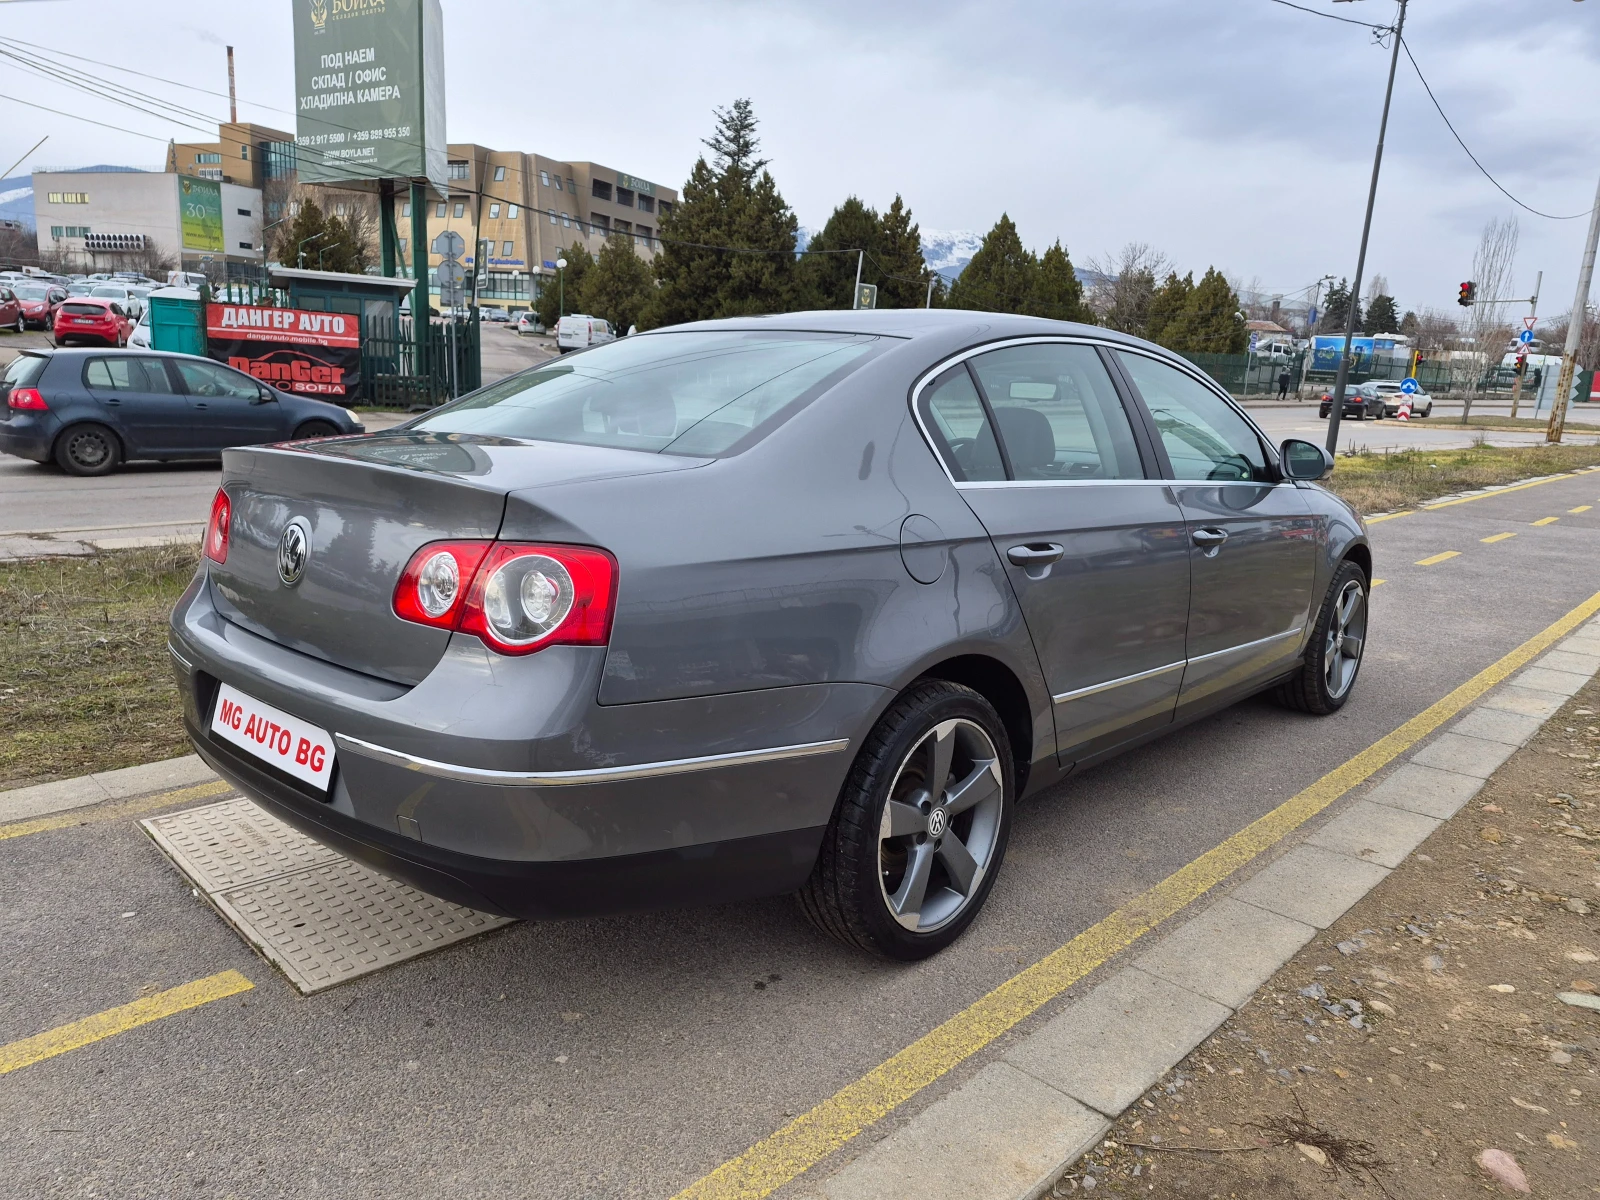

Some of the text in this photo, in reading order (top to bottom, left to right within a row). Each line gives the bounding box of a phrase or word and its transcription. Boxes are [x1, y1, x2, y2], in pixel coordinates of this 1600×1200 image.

[321, 47, 375, 69] ПОД НАЕМ
[311, 66, 387, 89] СКЛАД / ОФИС
[300, 85, 401, 110] ХЛАДИЛНА КАМЕРА
[310, 135, 316, 145] 2
[316, 134, 328, 145] 917
[329, 132, 345, 144] 5500
[347, 131, 351, 142] /
[352, 130, 370, 141] +359
[383, 127, 397, 139] 955
[397, 126, 411, 138] 350
[186, 202, 206, 219] 30
[221, 307, 345, 334] ДАНГЕР АУТО
[246, 332, 328, 346] dangerauto.mobile.bg
[295, 382, 344, 394] SOFIA
[219, 698, 326, 773] MG AUTO BG
